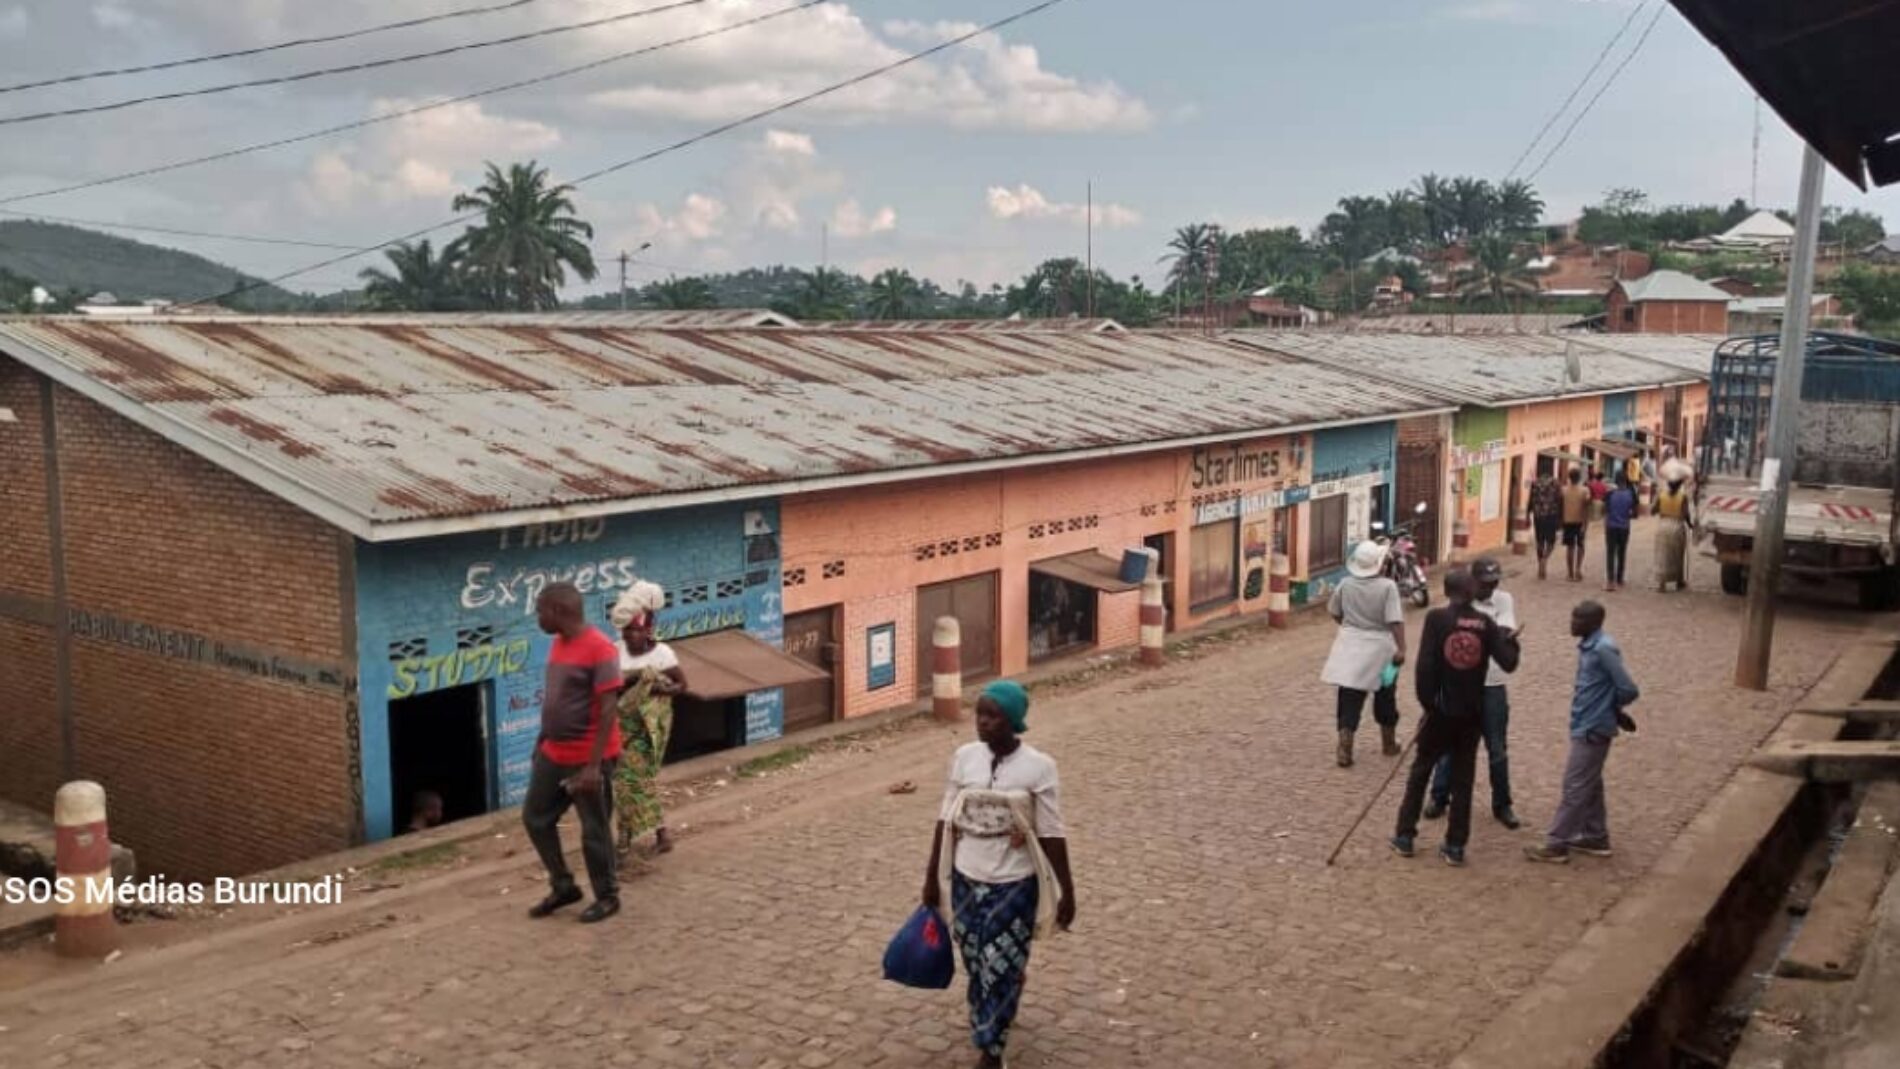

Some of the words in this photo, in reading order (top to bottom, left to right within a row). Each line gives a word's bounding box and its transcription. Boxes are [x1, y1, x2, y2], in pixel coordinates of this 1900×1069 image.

[1191, 444, 1280, 489] StarTimes
[67, 607, 206, 659] HABILLEMENT
[387, 638, 531, 699] STUDIO
